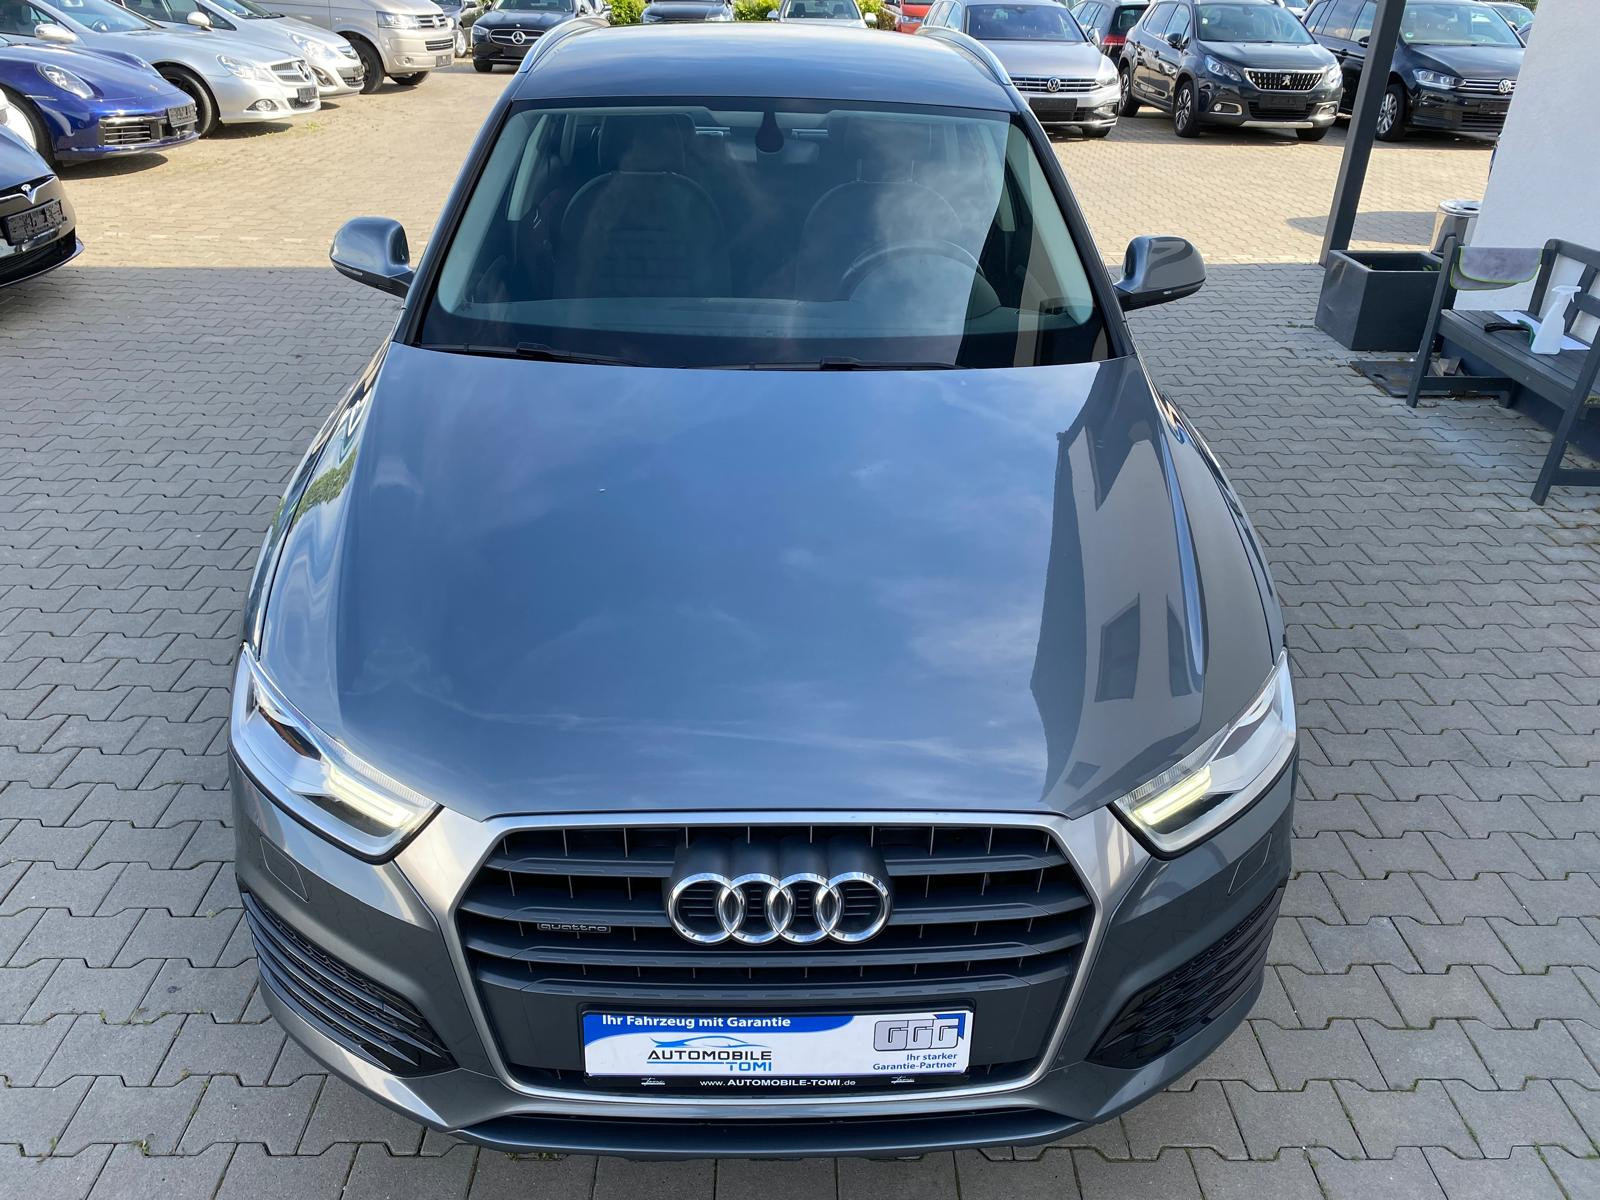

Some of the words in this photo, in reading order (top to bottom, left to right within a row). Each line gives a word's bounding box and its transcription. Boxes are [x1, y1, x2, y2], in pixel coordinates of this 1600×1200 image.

[540, 923, 608, 932] quattro
[602, 1014, 623, 1026] Ihr
[626, 1015, 696, 1028] Fahrzeug
[698, 1016, 724, 1027] mit
[726, 1016, 791, 1028] Garantie
[873, 1019, 960, 1051] GGG
[647, 1050, 772, 1061] AUTOMOBILE
[906, 1053, 921, 1061] Ihr
[922, 1052, 958, 1061] starker
[725, 1061, 772, 1072] TOMI
[872, 1061, 958, 1071] Garantie-Partner
